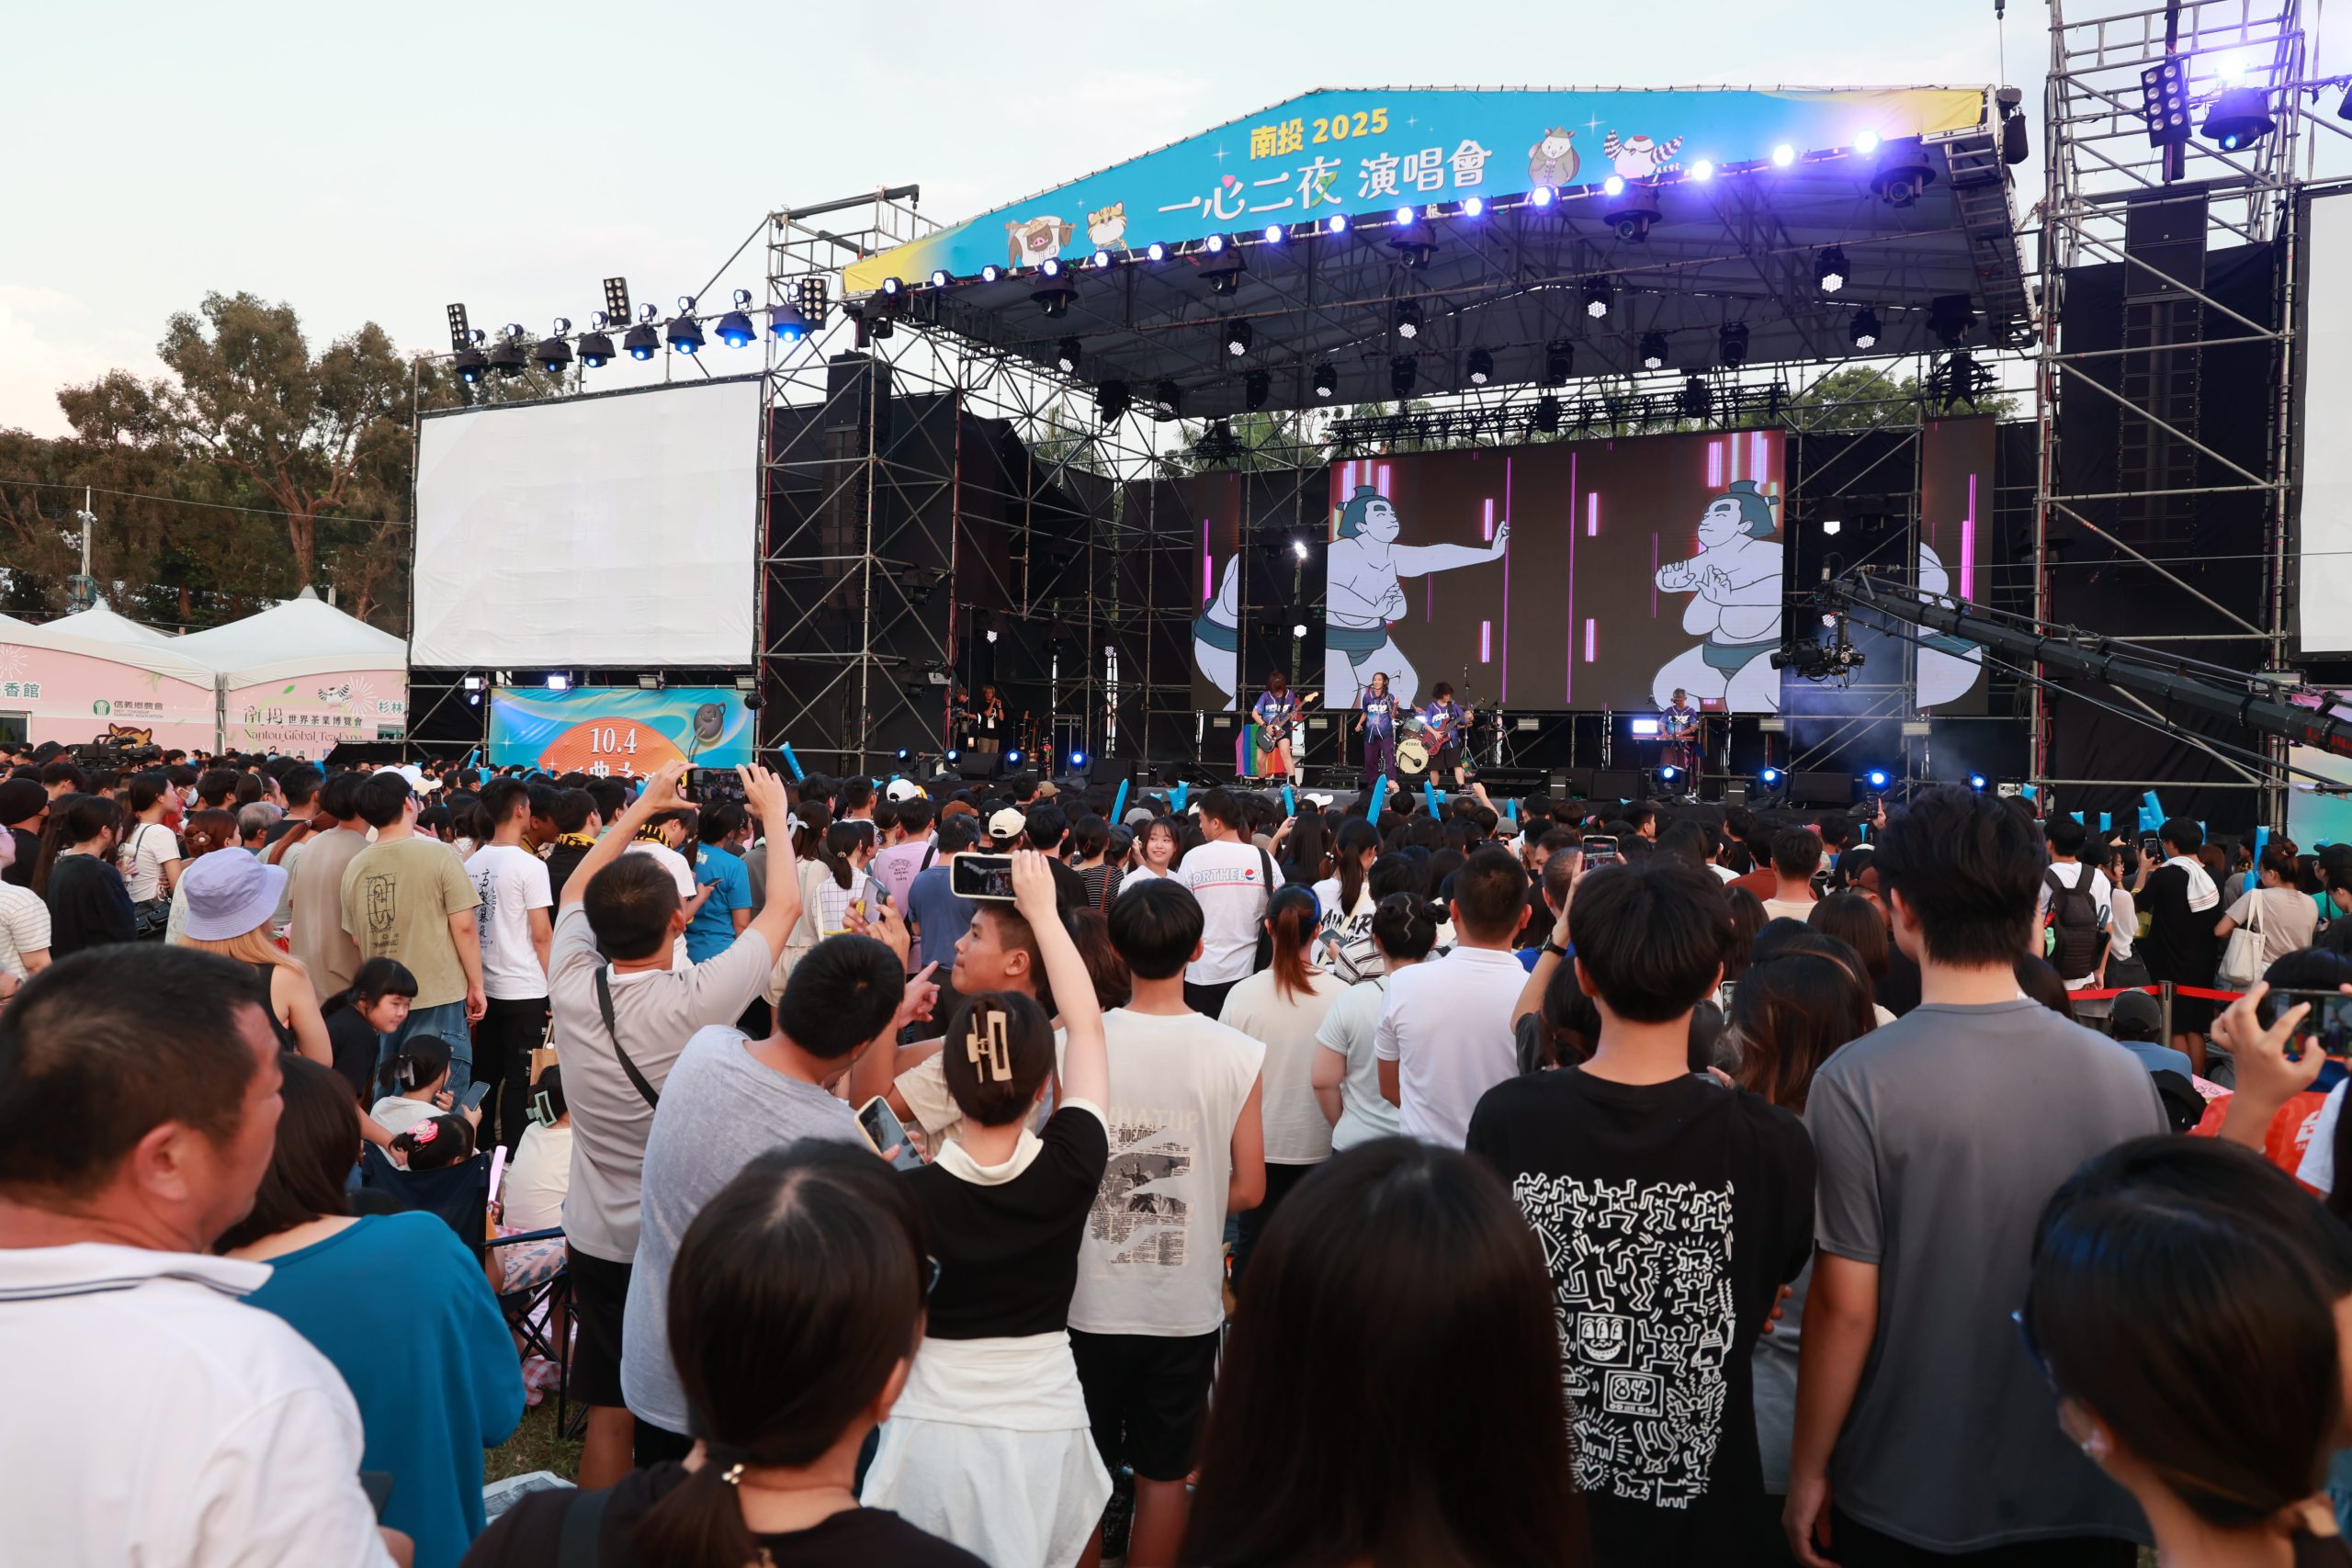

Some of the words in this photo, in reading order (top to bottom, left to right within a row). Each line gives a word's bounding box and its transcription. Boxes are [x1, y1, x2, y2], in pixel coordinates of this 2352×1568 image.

[1250, 118, 1304, 160] 南投
[1312, 107, 1389, 143] 2025
[1158, 157, 1341, 221] 一心二夜
[1357, 139, 1493, 200] 演唱會
[0, 682, 40, 698] 香館
[288, 715, 363, 727] 世界茶業博覽會
[244, 729, 282, 741] Nantou
[284, 730, 316, 741] Global
[319, 731, 336, 741] Tea
[591, 728, 638, 754] 10.4
[1613, 1377, 1650, 1402] 84
